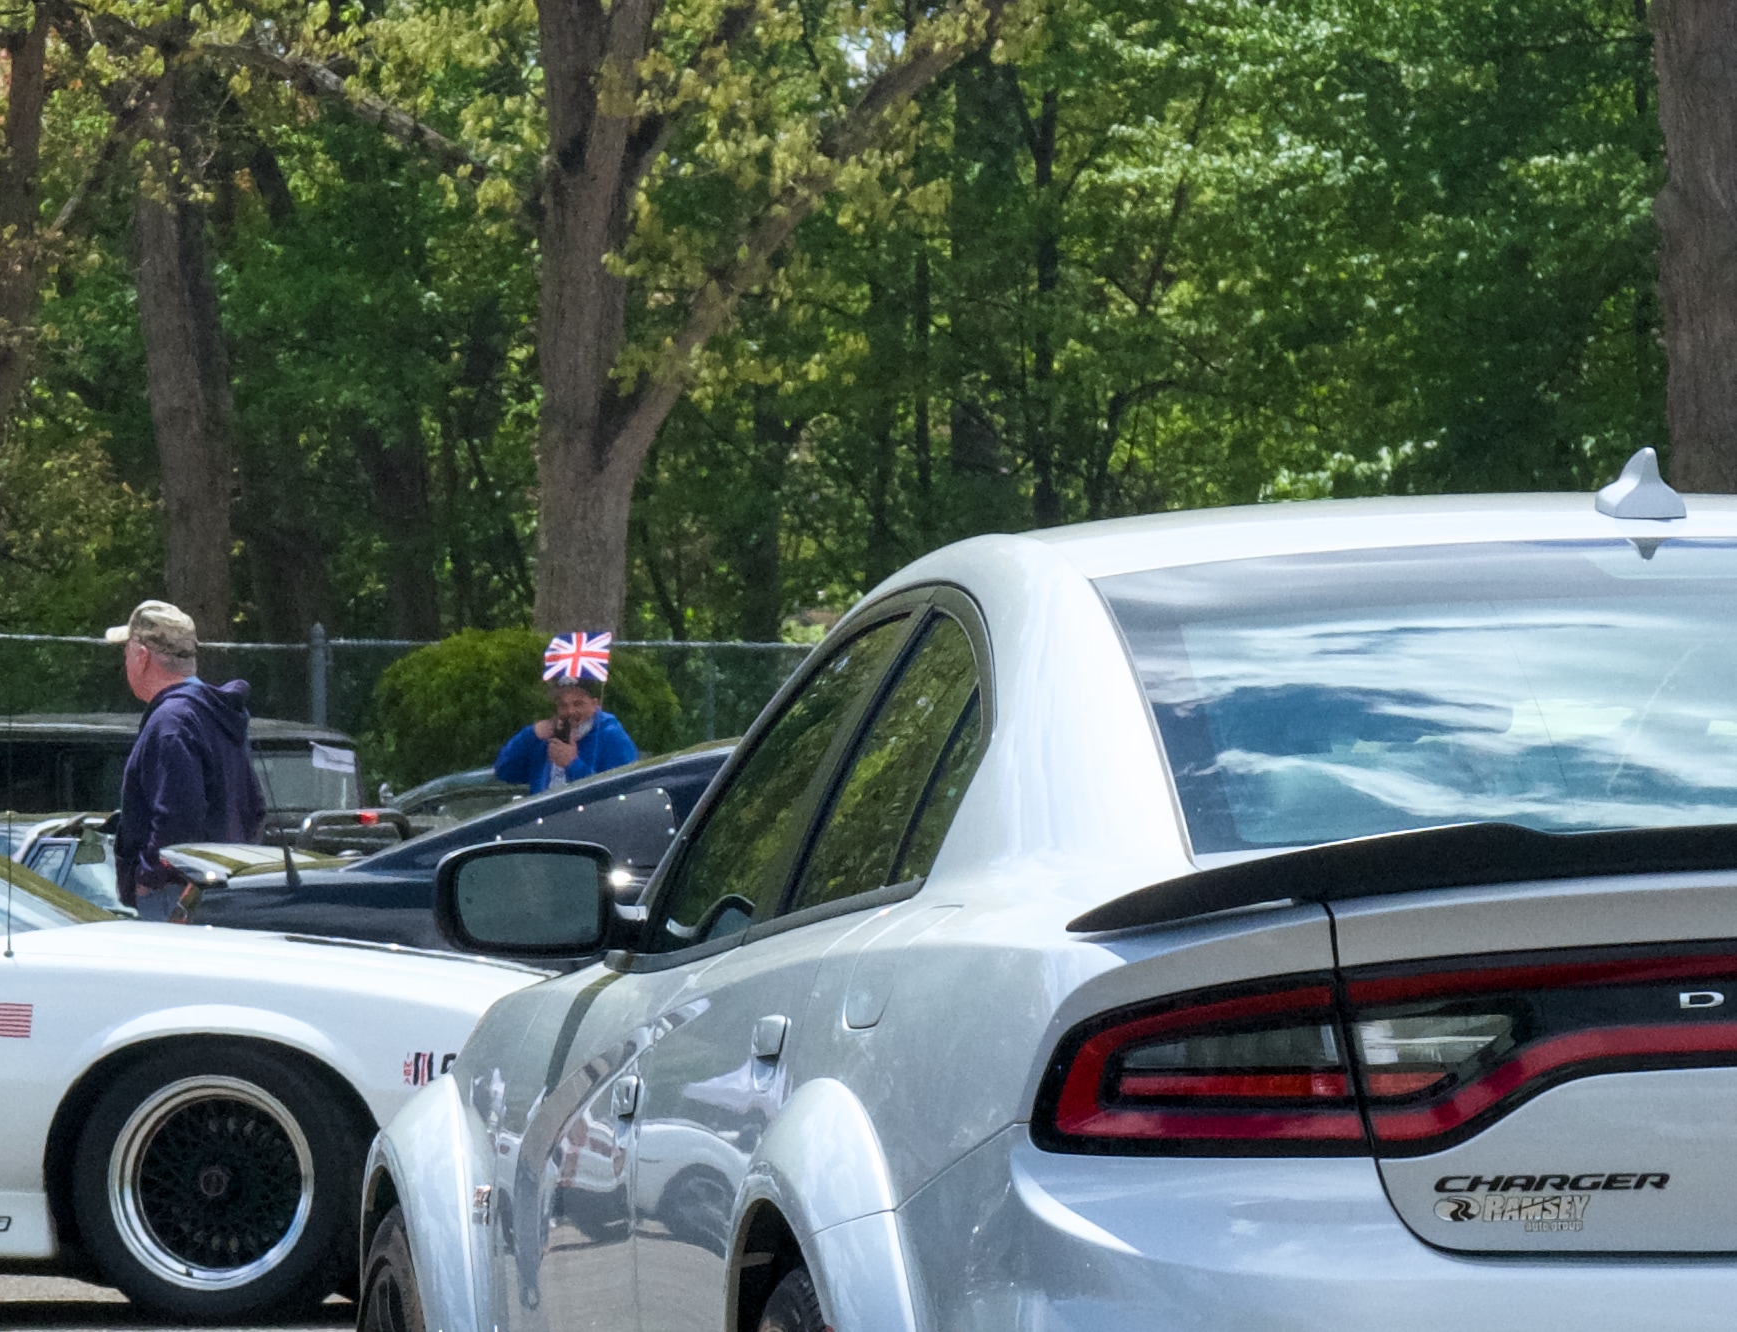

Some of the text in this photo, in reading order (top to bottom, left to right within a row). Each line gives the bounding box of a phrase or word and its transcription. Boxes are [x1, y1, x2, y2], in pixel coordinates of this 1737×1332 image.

[1434, 1172, 1670, 1193] CHARGER
[1483, 1194, 1591, 1222] RAMSEY
[1524, 1219, 1584, 1233] auto group
